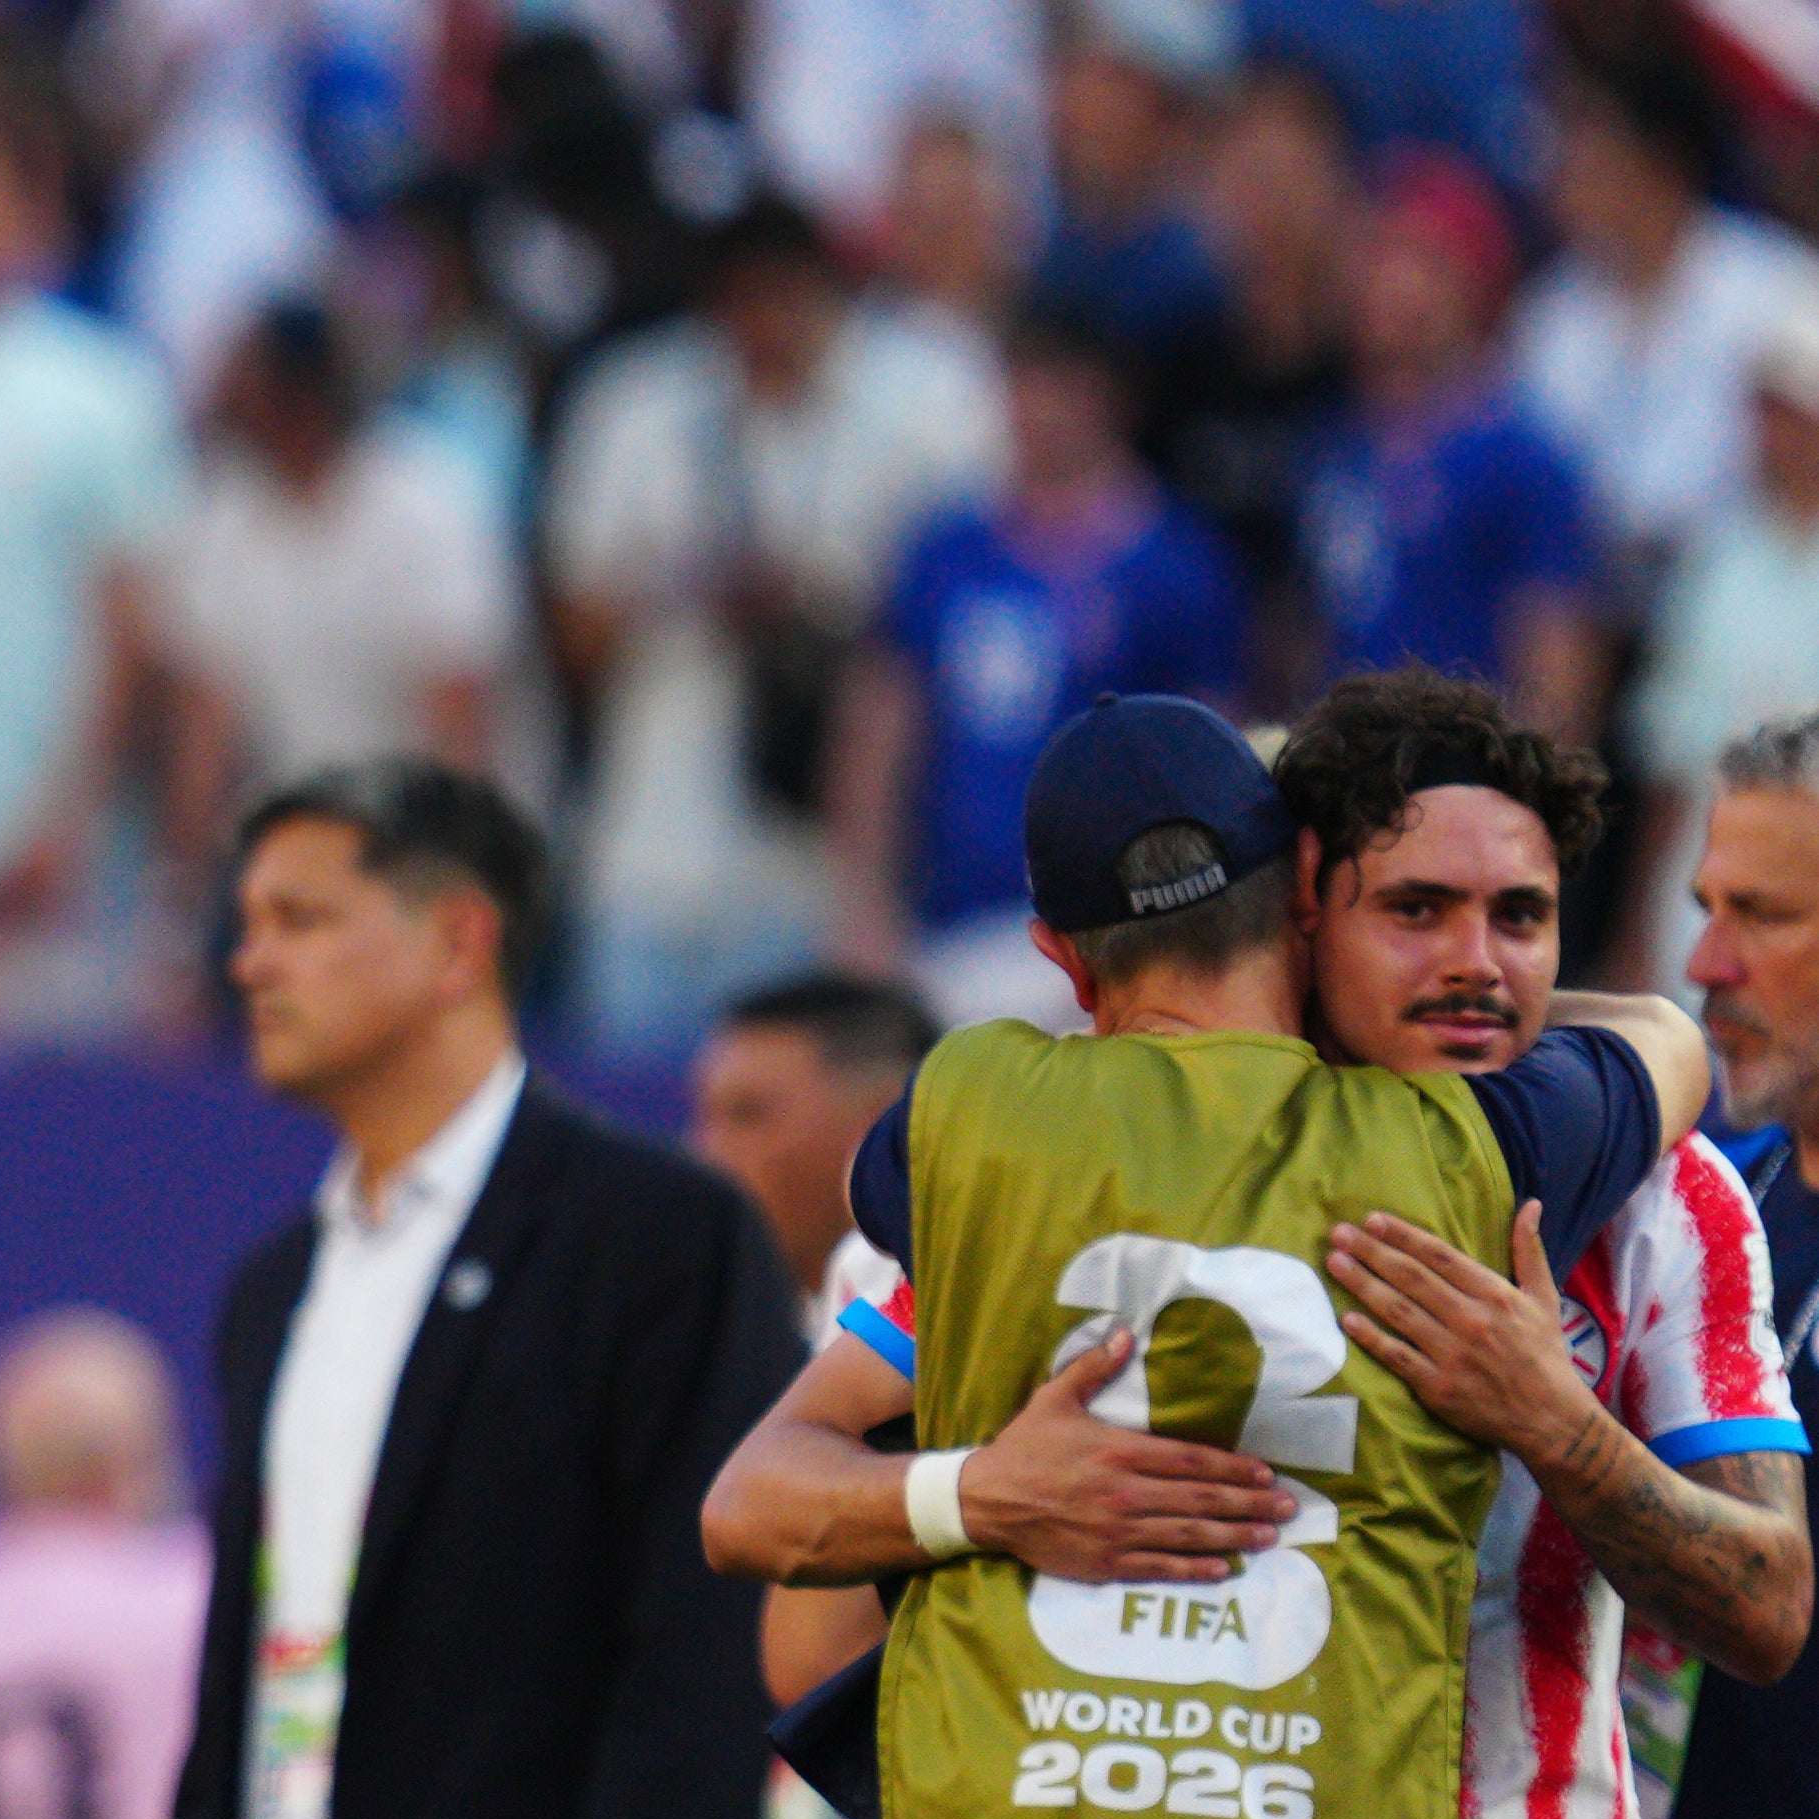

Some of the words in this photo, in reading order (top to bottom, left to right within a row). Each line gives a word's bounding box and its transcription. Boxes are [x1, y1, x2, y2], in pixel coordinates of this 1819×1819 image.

[1129, 862, 1228, 915] PUMA
[1120, 1591, 1248, 1643] FIFA
[1021, 1688, 1212, 1739] WORLD
[1218, 1704, 1323, 1755] CUP
